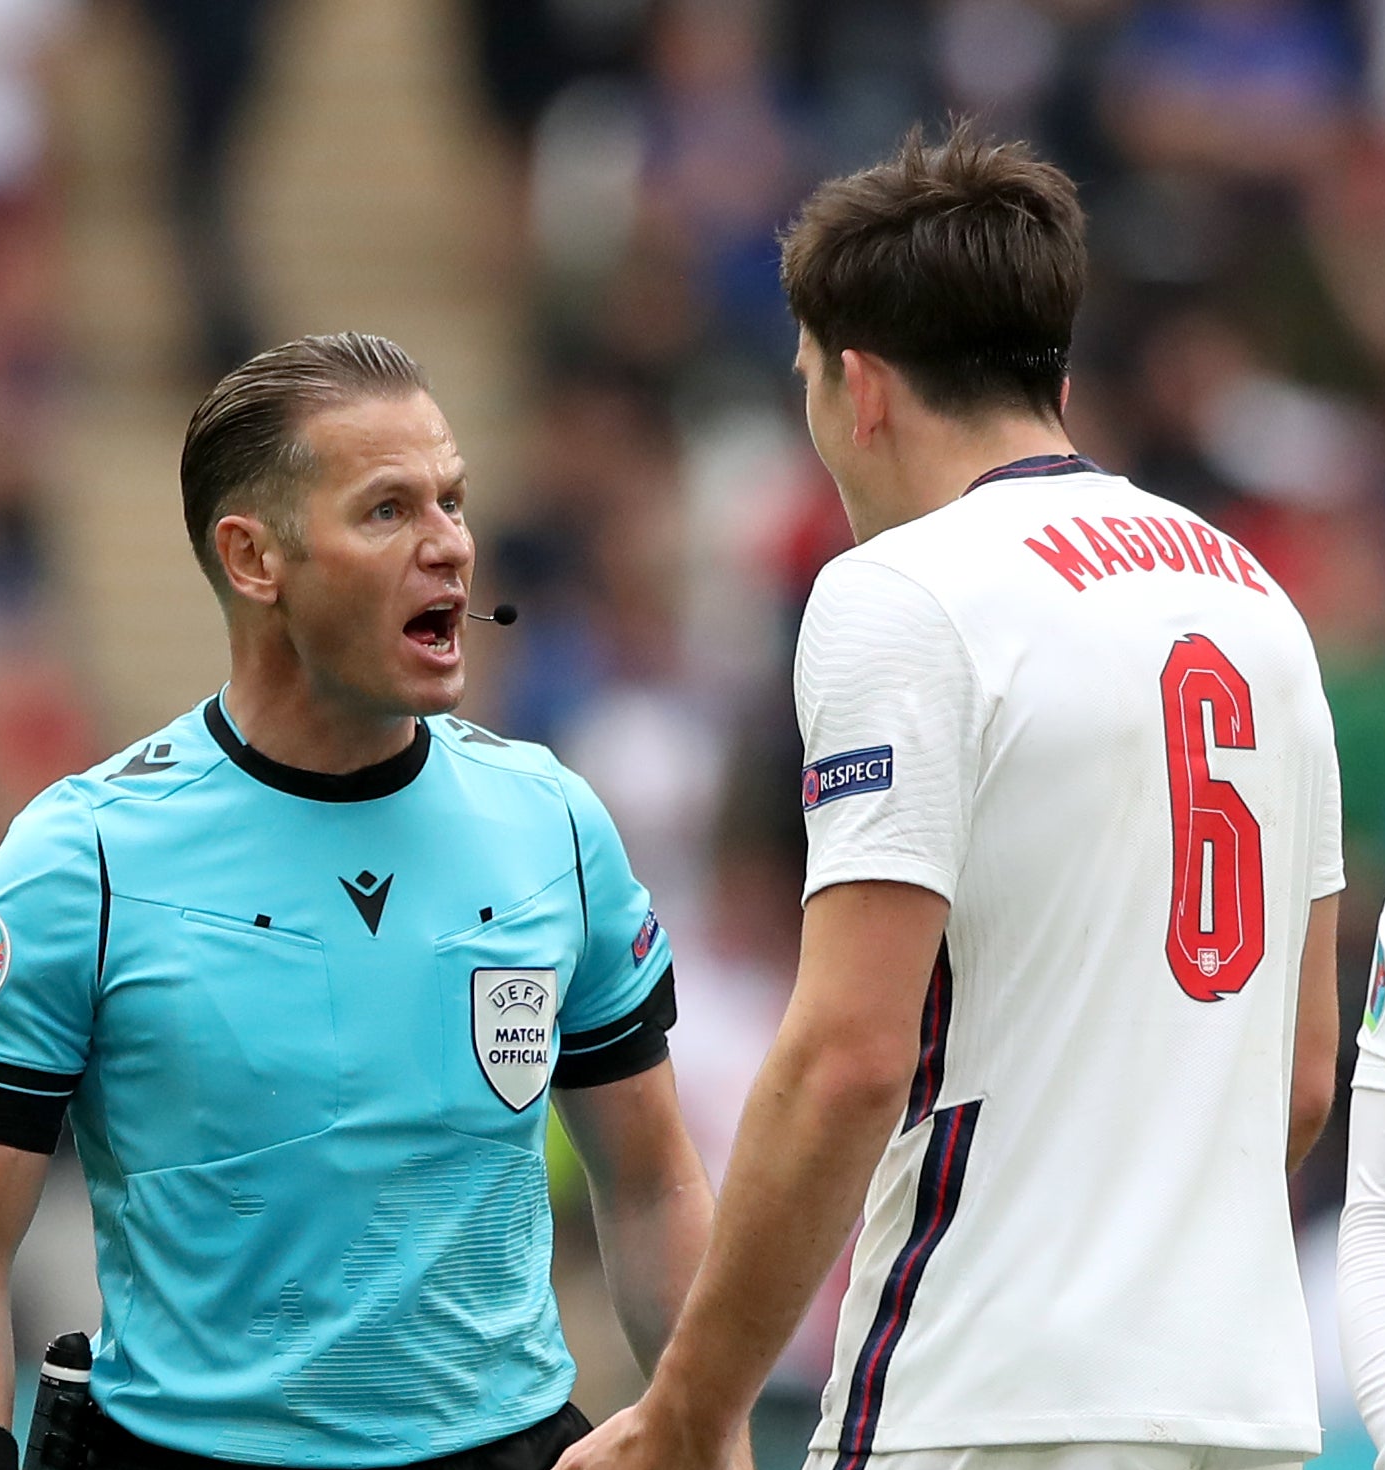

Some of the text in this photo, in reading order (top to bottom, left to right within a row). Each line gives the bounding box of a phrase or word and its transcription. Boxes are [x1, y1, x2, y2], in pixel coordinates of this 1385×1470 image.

[1023, 516, 1270, 597] MAGUIRE
[820, 758, 891, 791] RESPECT
[1159, 633, 1266, 1003] 6
[492, 985, 544, 1009] UEFA
[495, 1028, 545, 1043] MATCH
[489, 1049, 548, 1065] OFFICIAL
